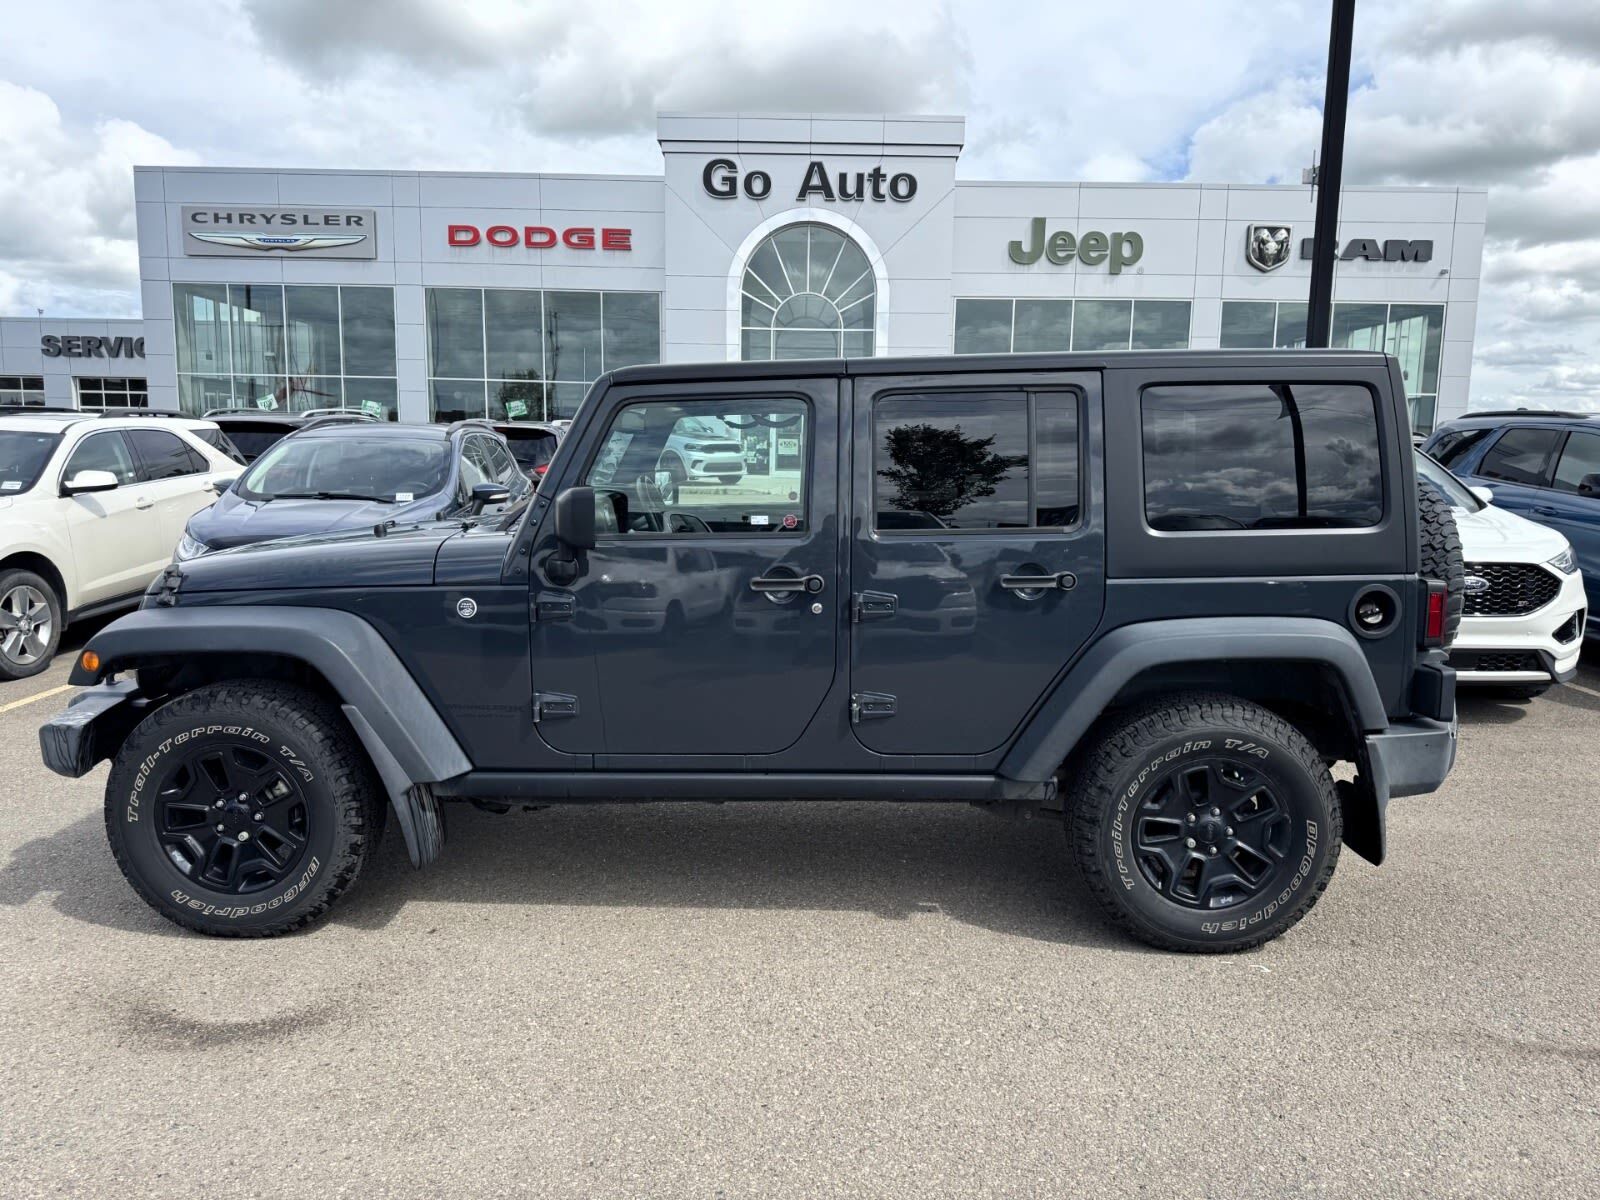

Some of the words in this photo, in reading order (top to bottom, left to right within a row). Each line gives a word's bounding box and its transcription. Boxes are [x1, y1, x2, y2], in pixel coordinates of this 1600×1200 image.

[702, 158, 772, 200] Go
[796, 160, 919, 202] Auto
[191, 211, 365, 227] CHRYSLER
[447, 225, 633, 251] DODGE
[1008, 217, 1144, 274] Jeep
[127, 725, 270, 823] Trail-Terrain
[280, 745, 314, 782] T/A
[1111, 738, 1212, 890] Trail-Terrain
[1223, 738, 1270, 760] T/A
[170, 856, 320, 919] BFGoodrich
[1201, 819, 1318, 935] BFGoodrich
